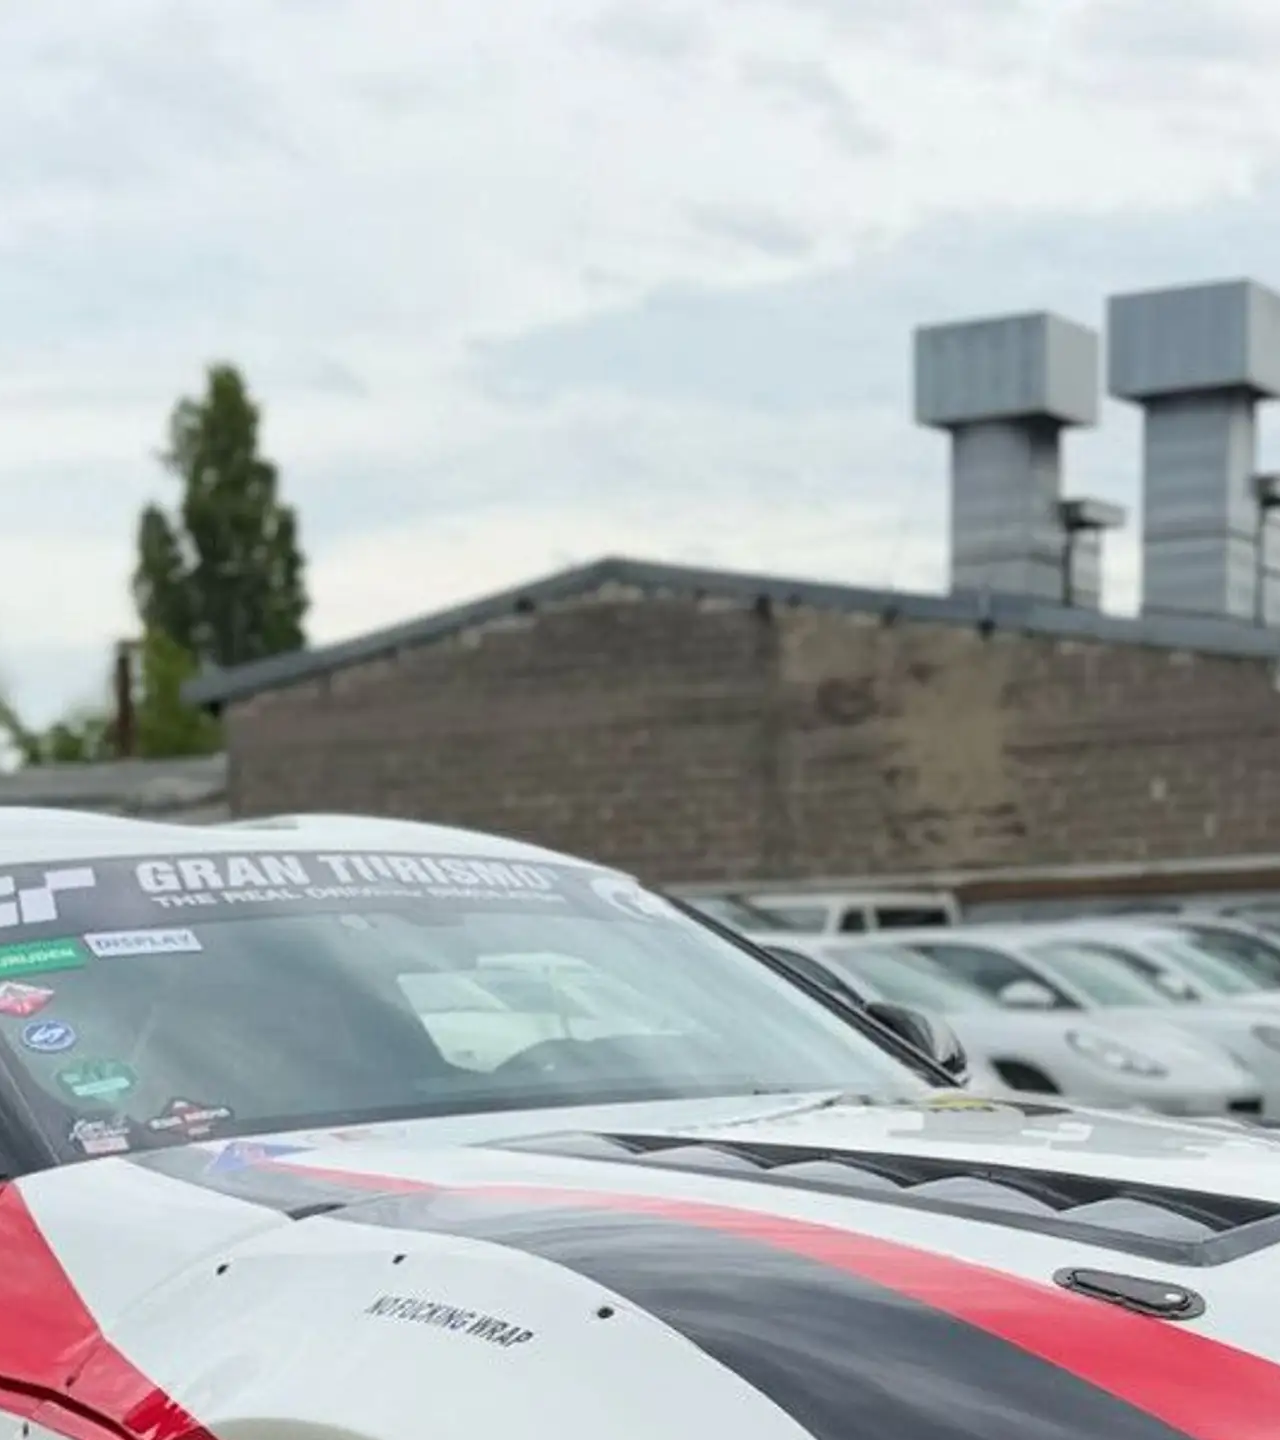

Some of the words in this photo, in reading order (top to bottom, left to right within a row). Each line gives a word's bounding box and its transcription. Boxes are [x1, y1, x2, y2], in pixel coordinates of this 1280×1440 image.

[134, 853, 311, 893] GRAN
[151, 892, 216, 909] THE
[96, 930, 191, 952] DISPLAY
[466, 1313, 534, 1348] WRAP
